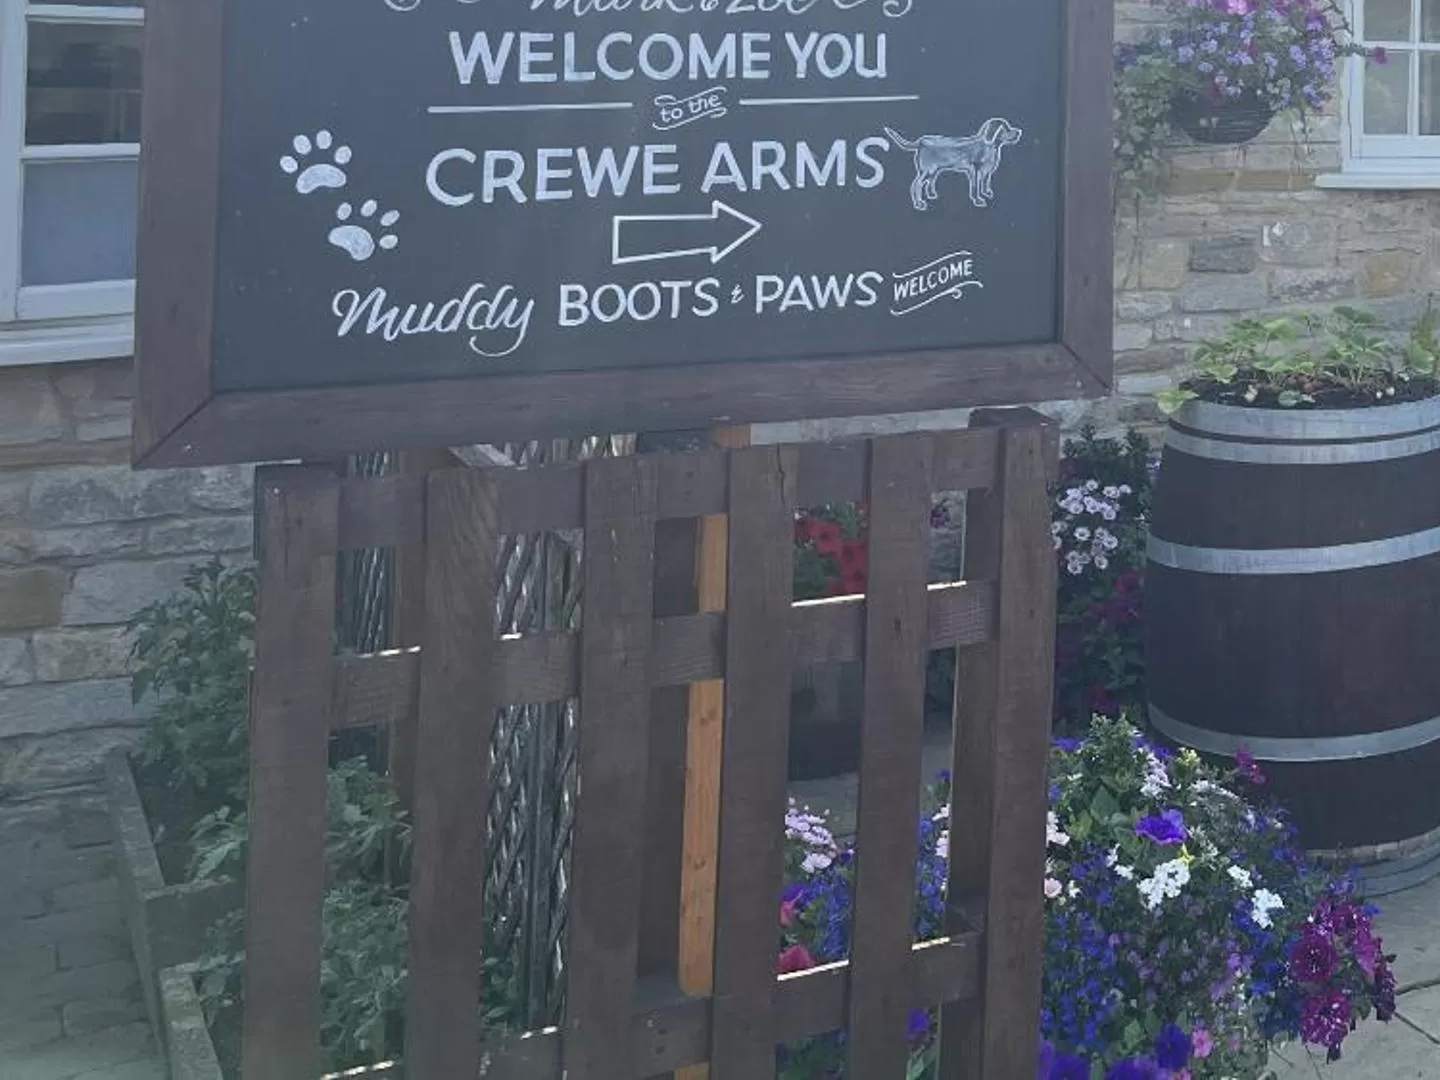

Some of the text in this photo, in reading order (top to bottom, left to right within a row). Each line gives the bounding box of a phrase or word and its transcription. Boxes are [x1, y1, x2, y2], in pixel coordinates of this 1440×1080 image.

[449, 31, 887, 85] WELCOME YOU
[659, 94, 722, 123] to the
[425, 136, 890, 206] CREWE ARMS
[892, 257, 974, 302] WELCOME
[332, 283, 534, 357] Muddy
[558, 277, 719, 327] BOOTS
[755, 271, 884, 315] PAWS
